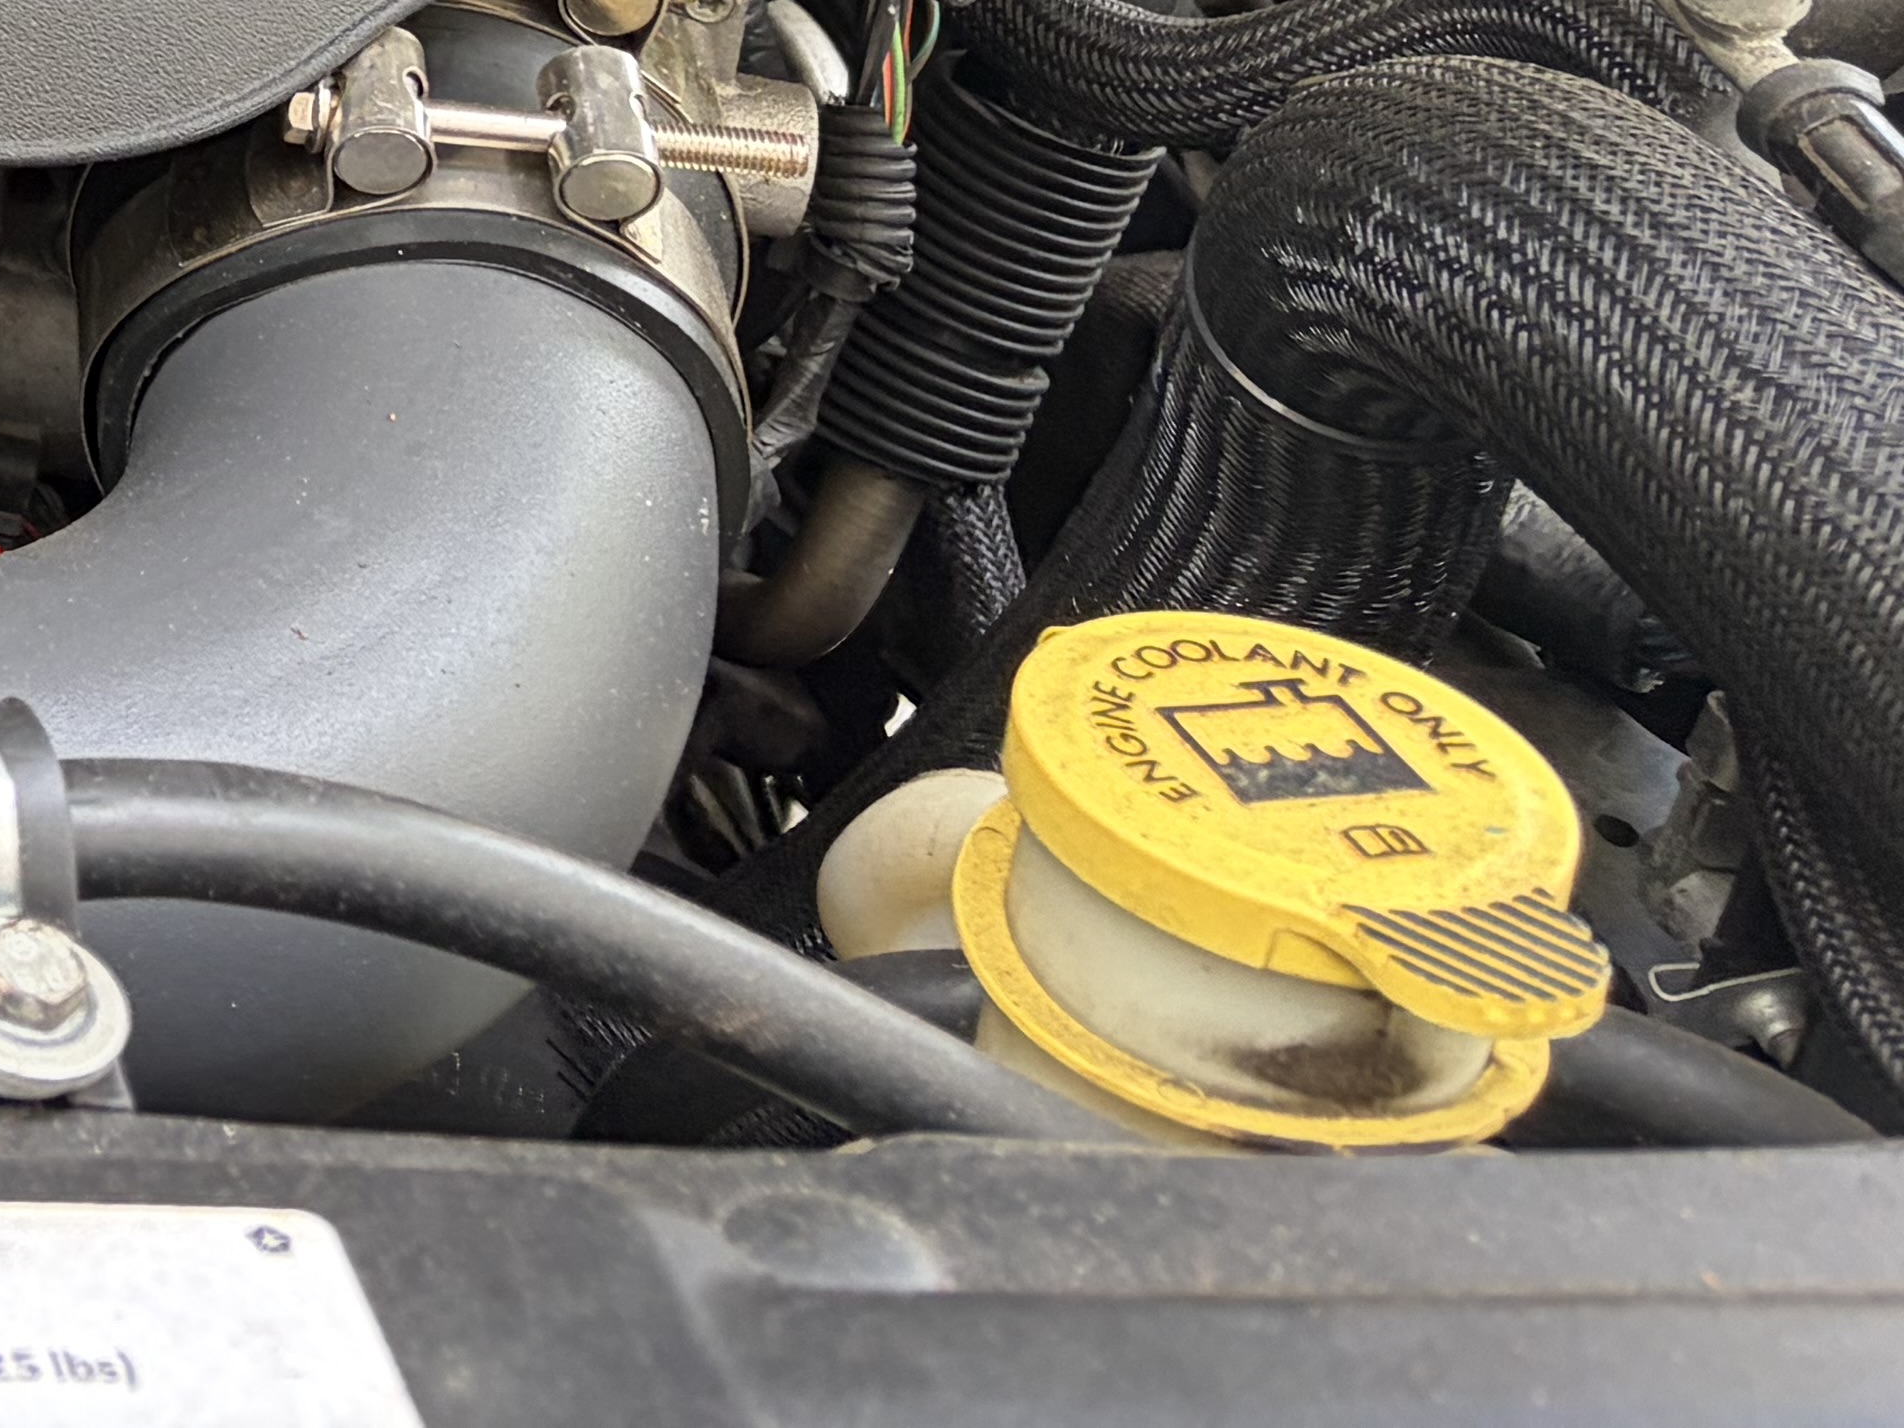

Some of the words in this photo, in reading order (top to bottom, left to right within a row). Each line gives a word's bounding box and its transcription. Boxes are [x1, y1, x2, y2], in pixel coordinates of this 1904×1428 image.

[1112, 638, 1368, 690] COOLANT
[1091, 681, 1199, 804] ENGINE
[1379, 690, 1498, 784] ONLY
